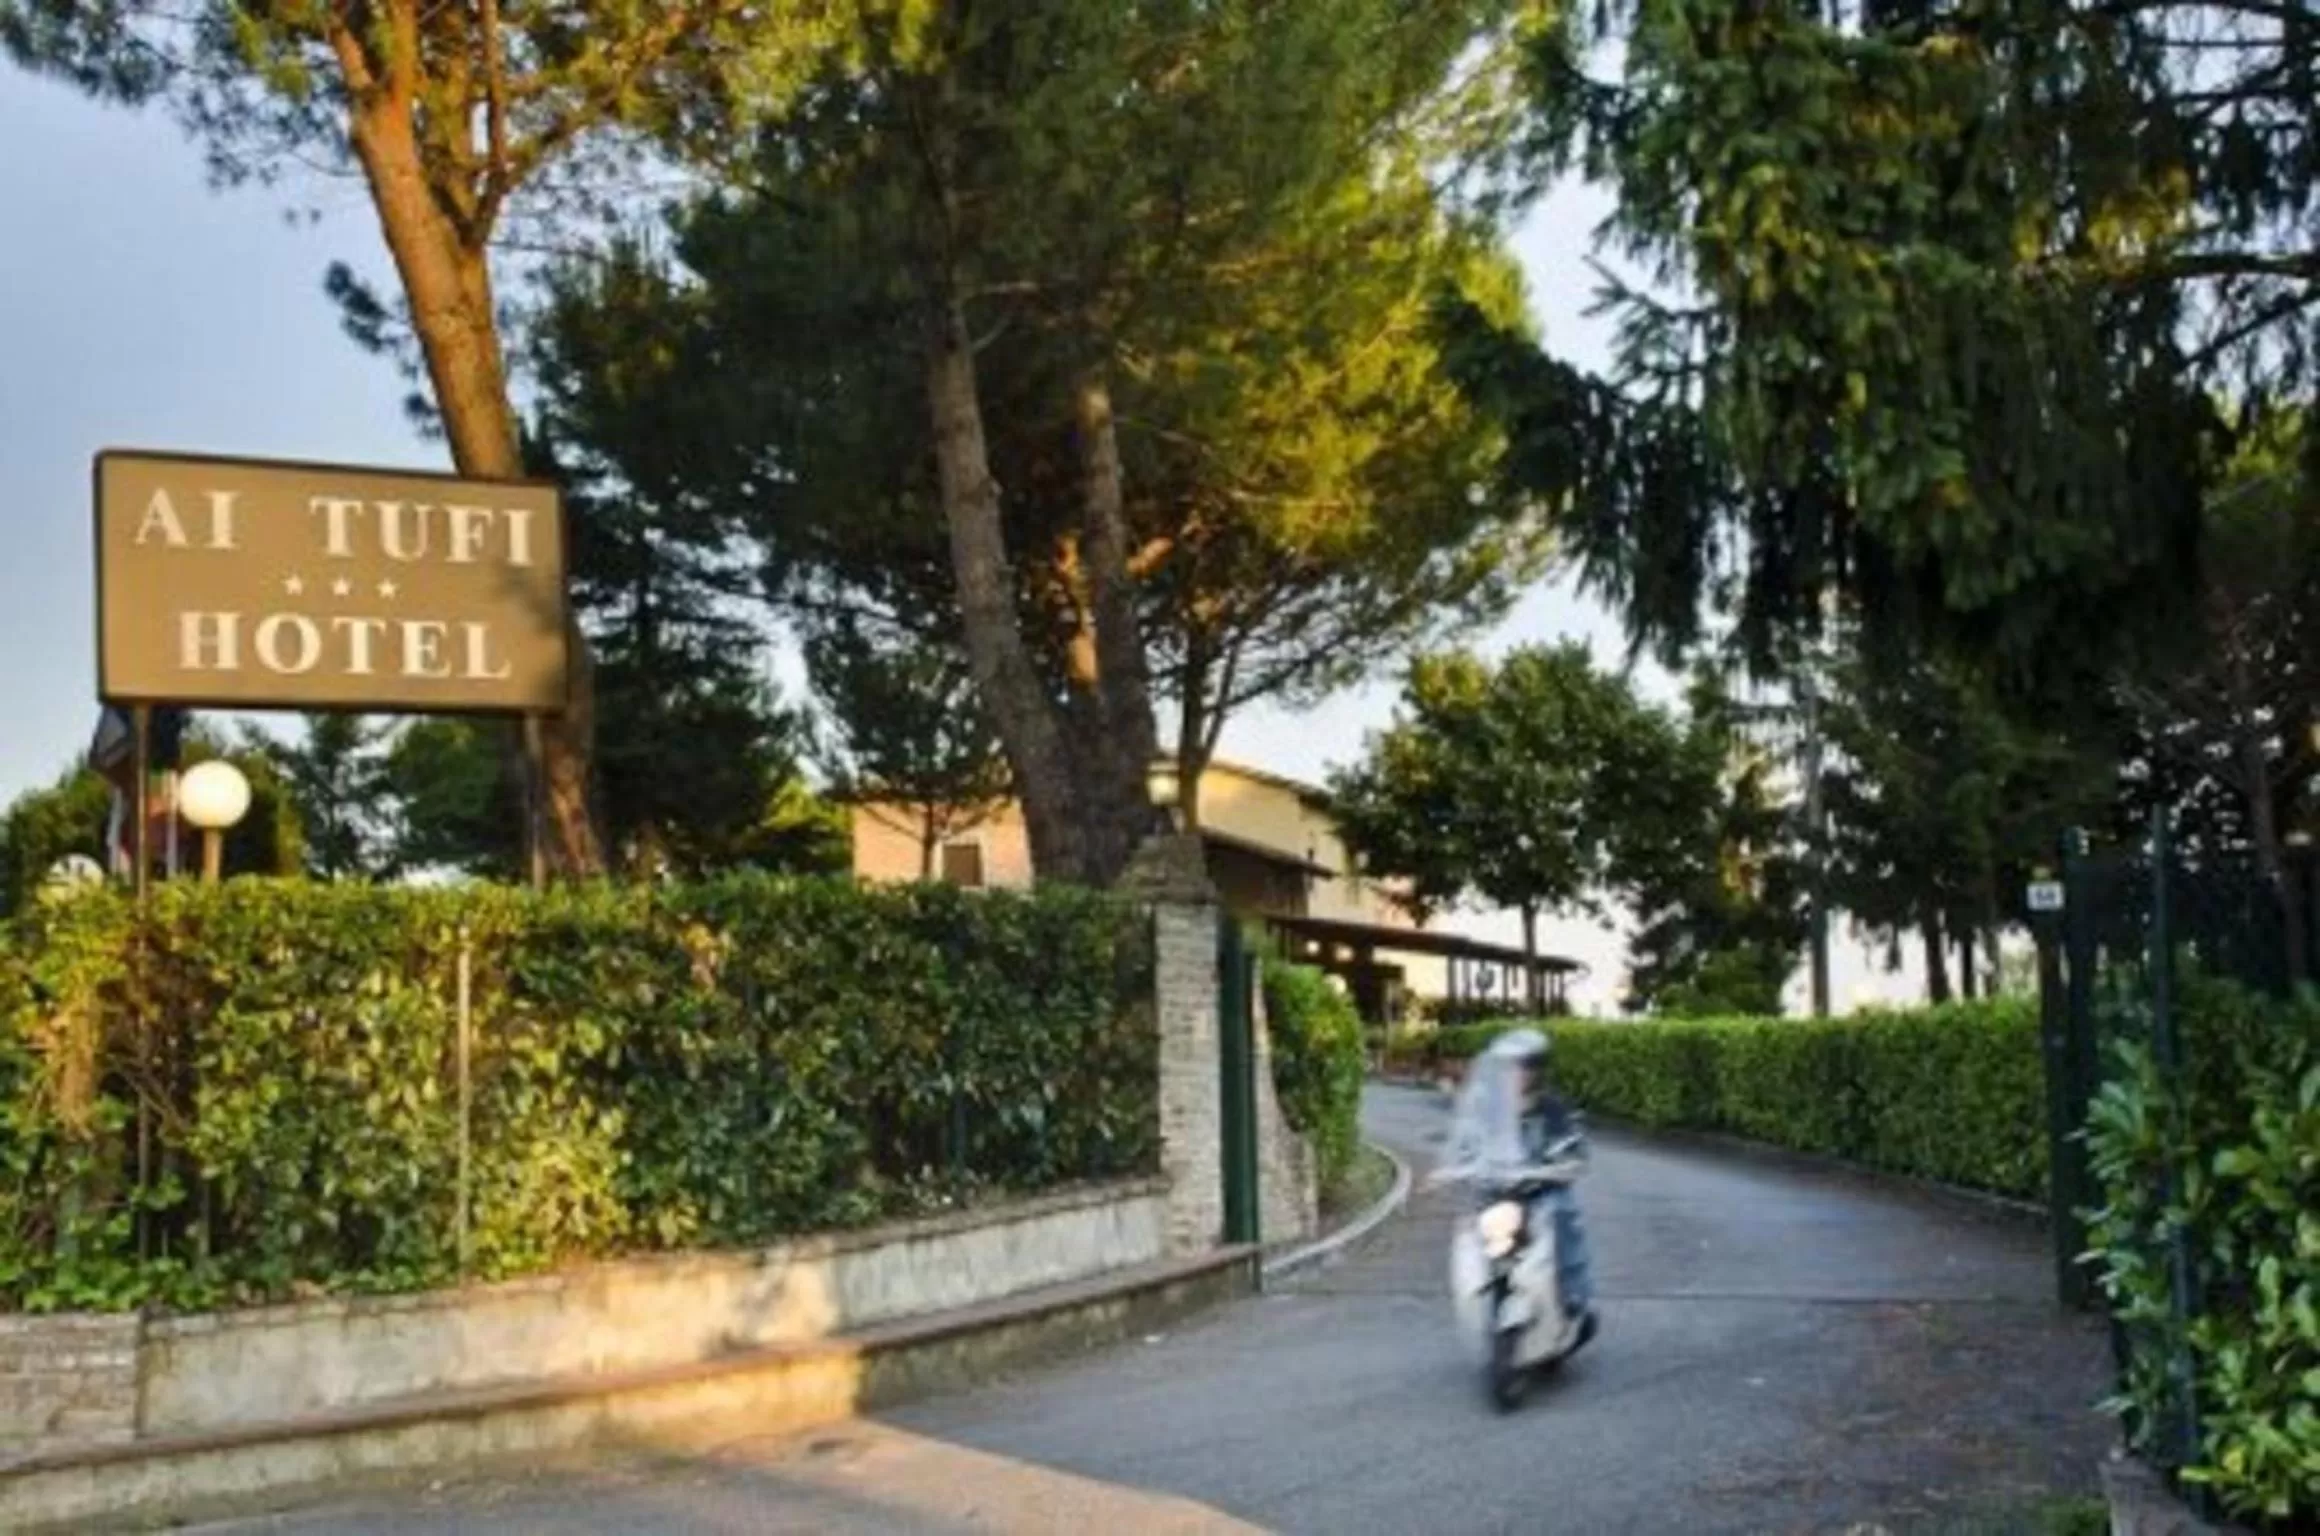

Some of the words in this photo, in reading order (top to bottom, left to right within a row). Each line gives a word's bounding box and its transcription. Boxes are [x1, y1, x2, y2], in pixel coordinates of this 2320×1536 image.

[135, 488, 239, 549] AI
[310, 496, 533, 566] TUFI
[179, 611, 512, 679] HOTEL
